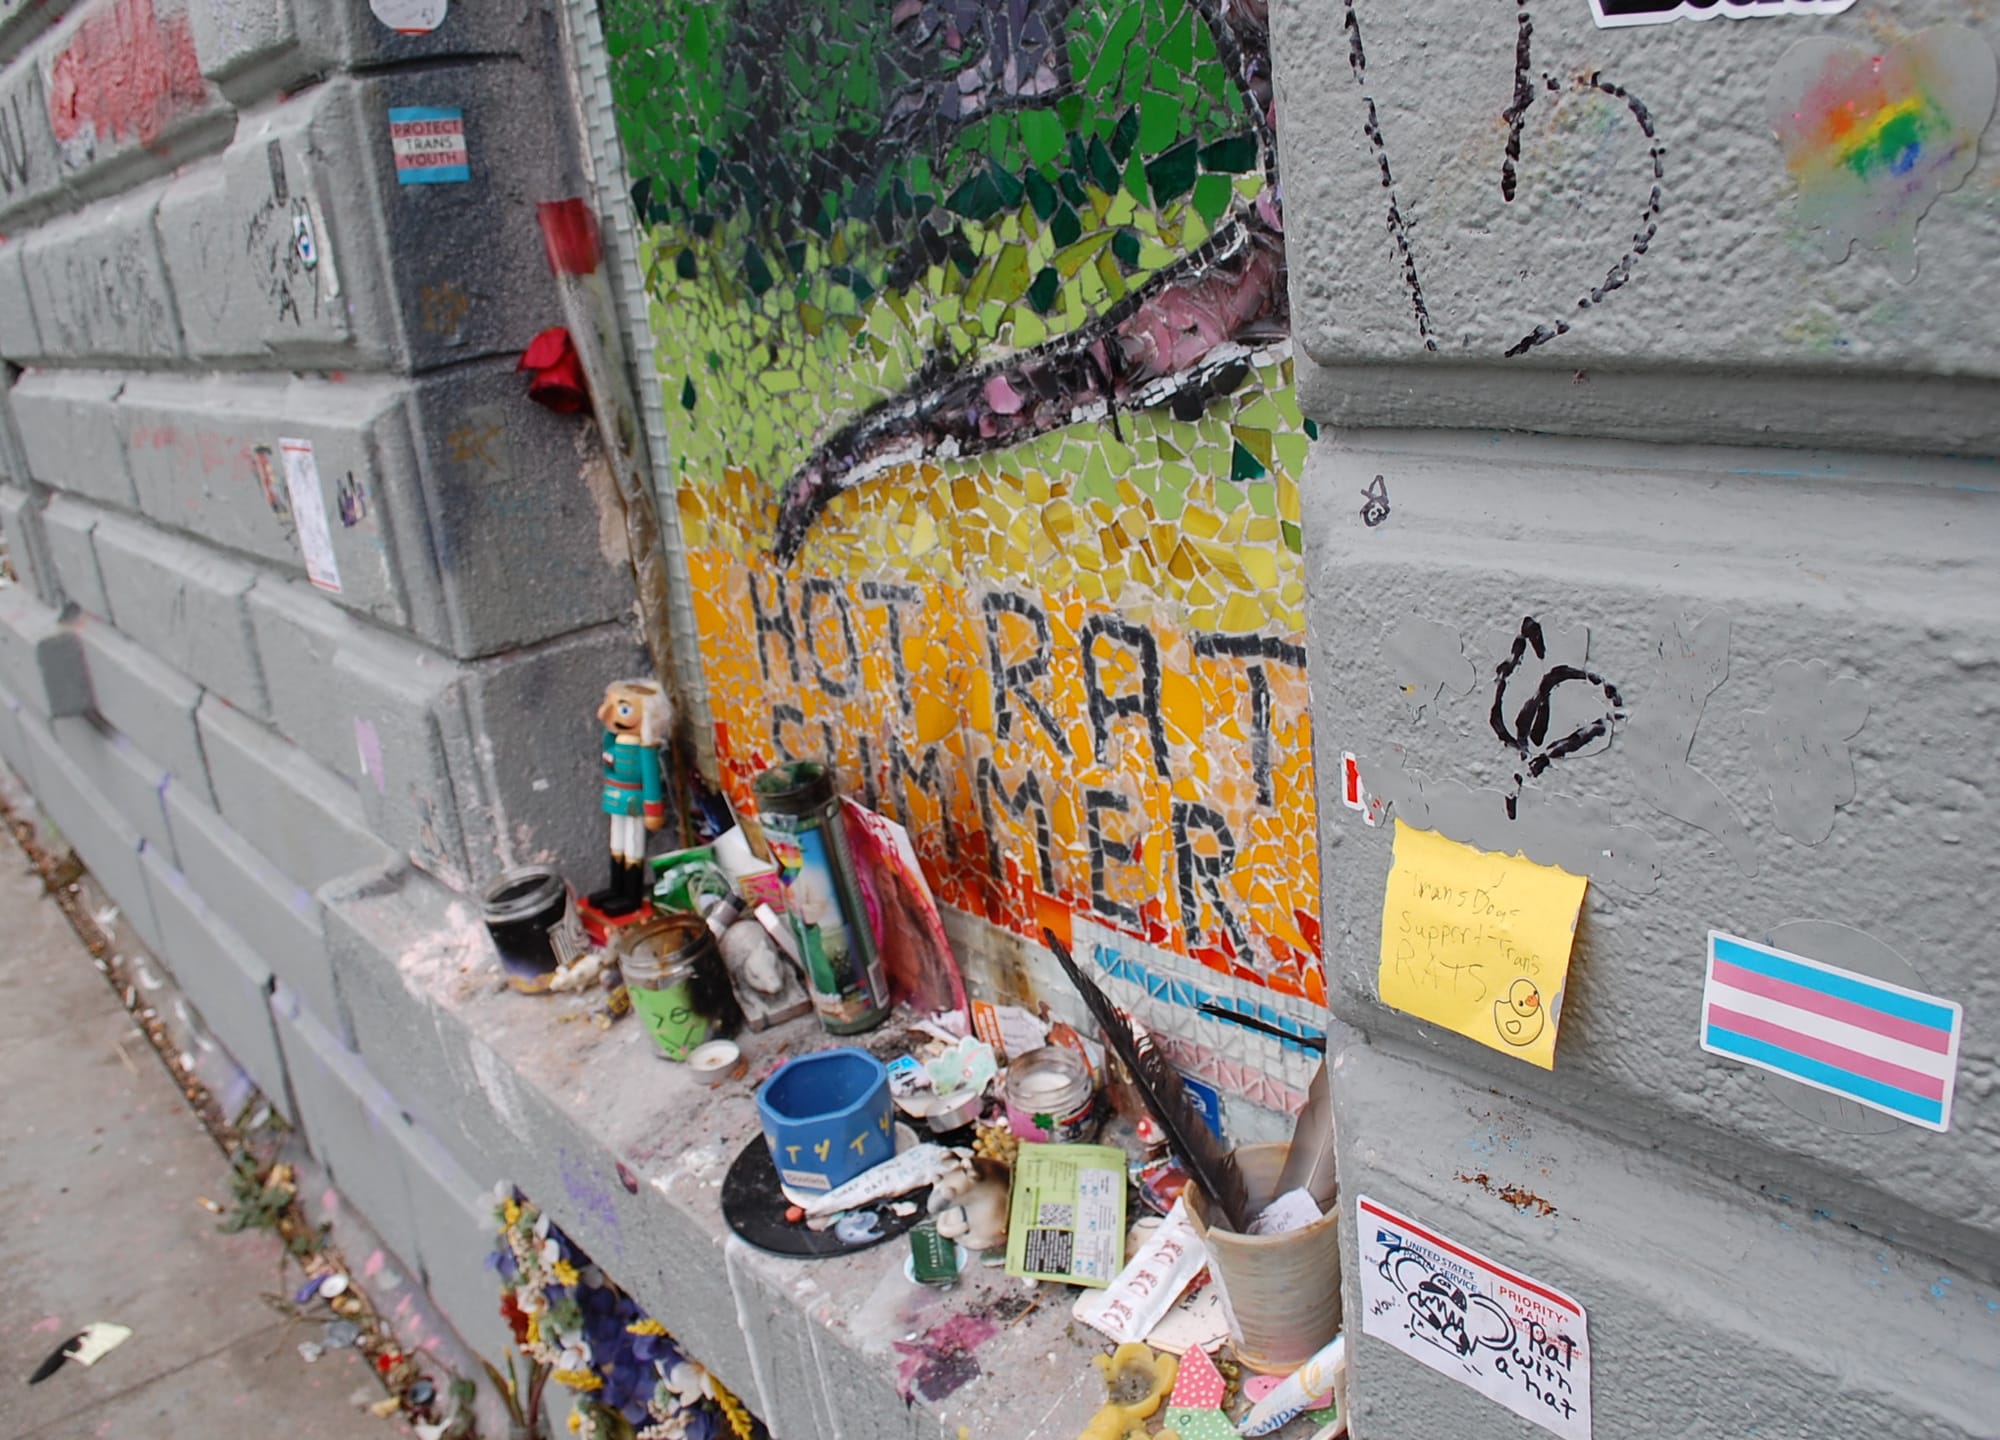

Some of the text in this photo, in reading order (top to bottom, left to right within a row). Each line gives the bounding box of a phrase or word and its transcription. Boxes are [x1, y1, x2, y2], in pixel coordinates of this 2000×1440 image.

[393, 120, 459, 136] PROTECT
[405, 135, 453, 151] TRANS
[406, 152, 457, 166] YOUTH
[748, 573, 1306, 807] HOT RAT
[1405, 1239, 1440, 1264] UNITED
[1440, 1255, 1475, 1281] STATES
[1439, 1267, 1479, 1294] SERVICE
[1514, 1305, 1549, 1328] MAIL
